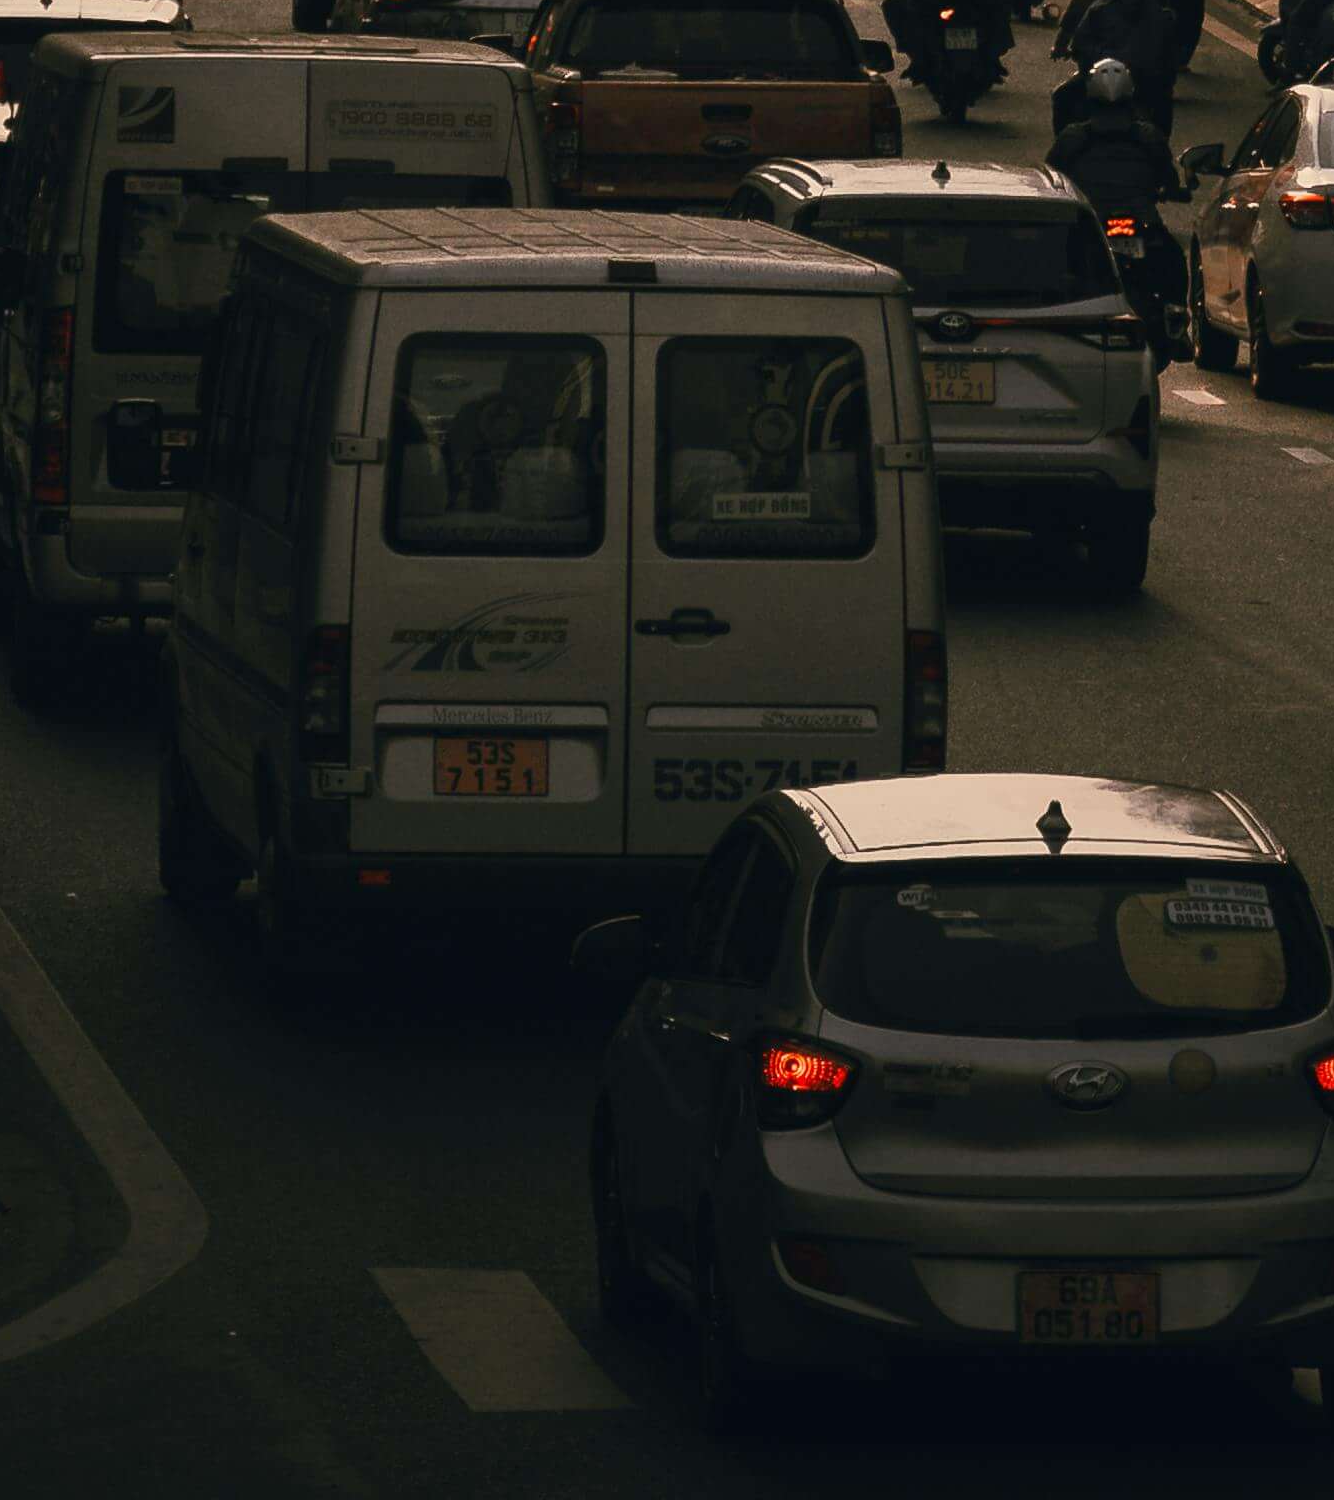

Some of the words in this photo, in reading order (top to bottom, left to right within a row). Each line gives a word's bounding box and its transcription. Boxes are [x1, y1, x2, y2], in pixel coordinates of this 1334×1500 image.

[432, 706, 508, 725] Mercedes
[512, 706, 554, 725] Benz
[467, 740, 516, 765] 53S
